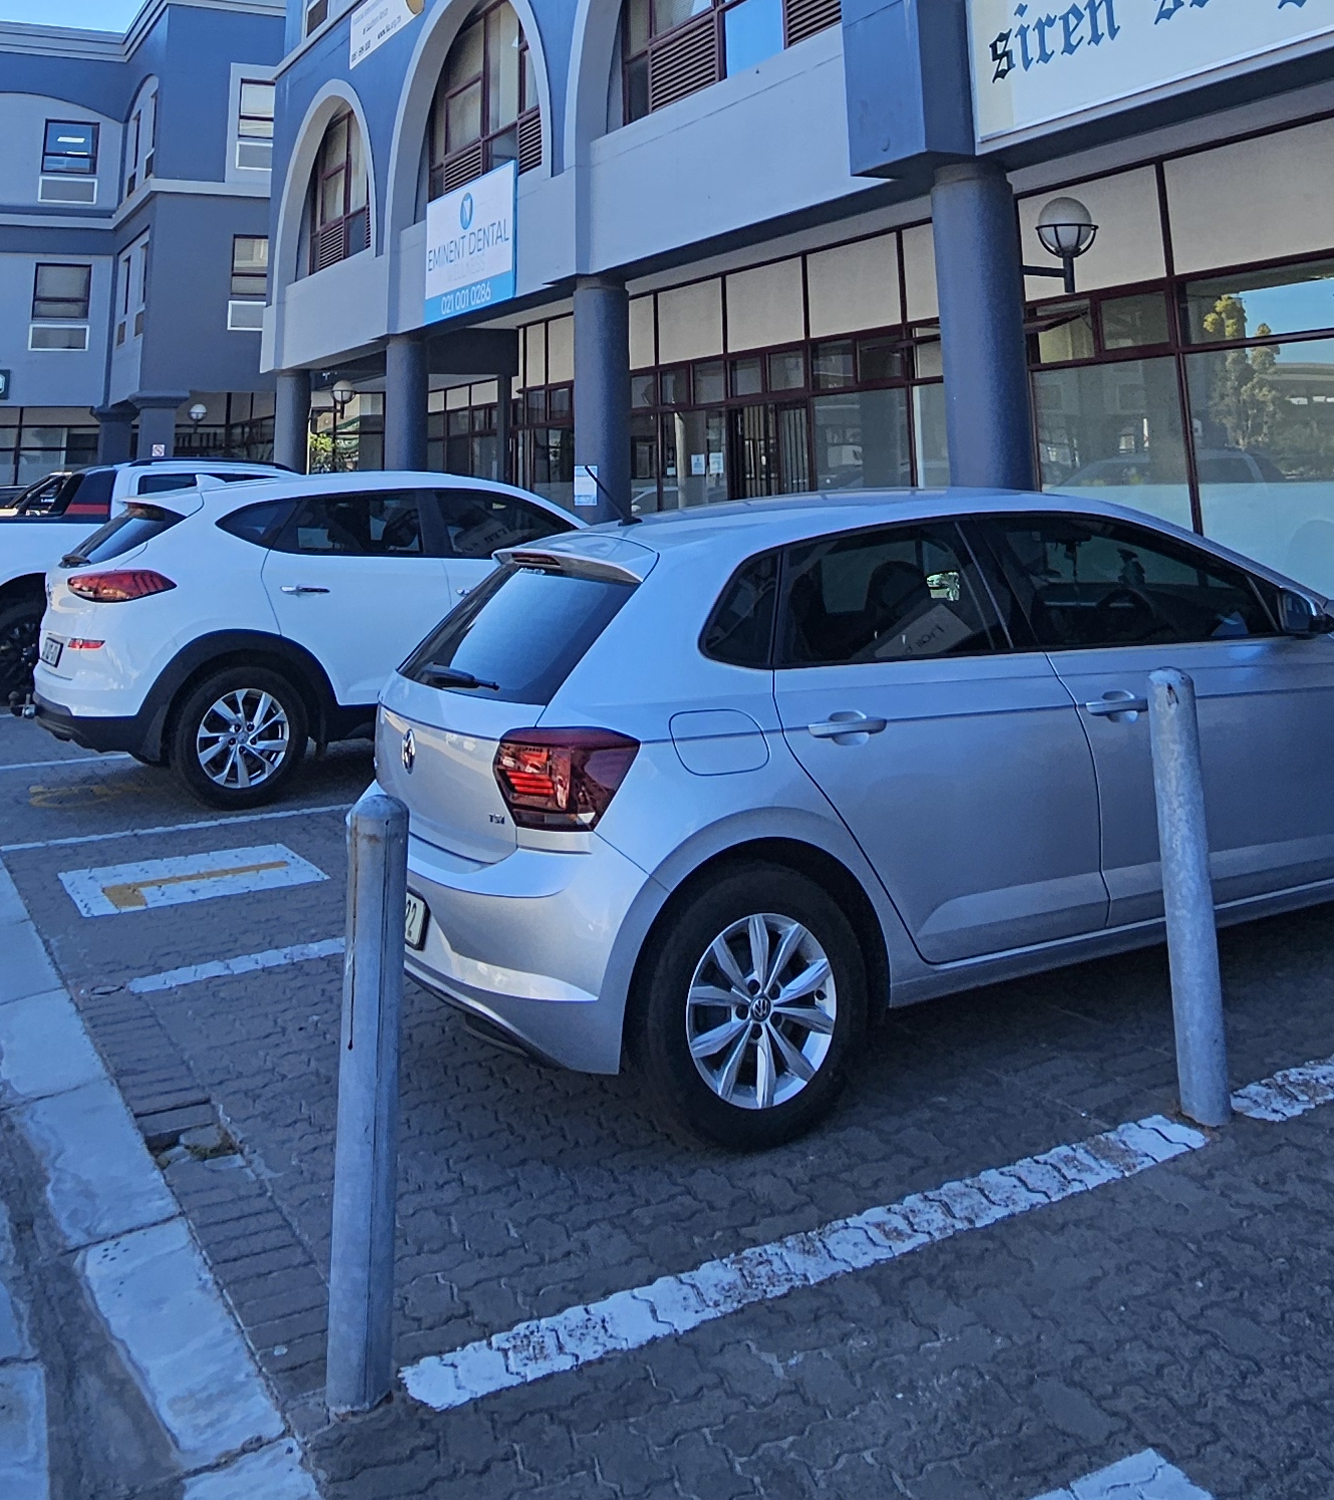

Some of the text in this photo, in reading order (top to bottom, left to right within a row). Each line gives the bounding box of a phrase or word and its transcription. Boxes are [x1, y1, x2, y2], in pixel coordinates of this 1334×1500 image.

[428, 218, 510, 272] EMINENT DENTAL
[440, 283, 491, 315] 021 001 0286
[488, 813, 505, 825] TSI
